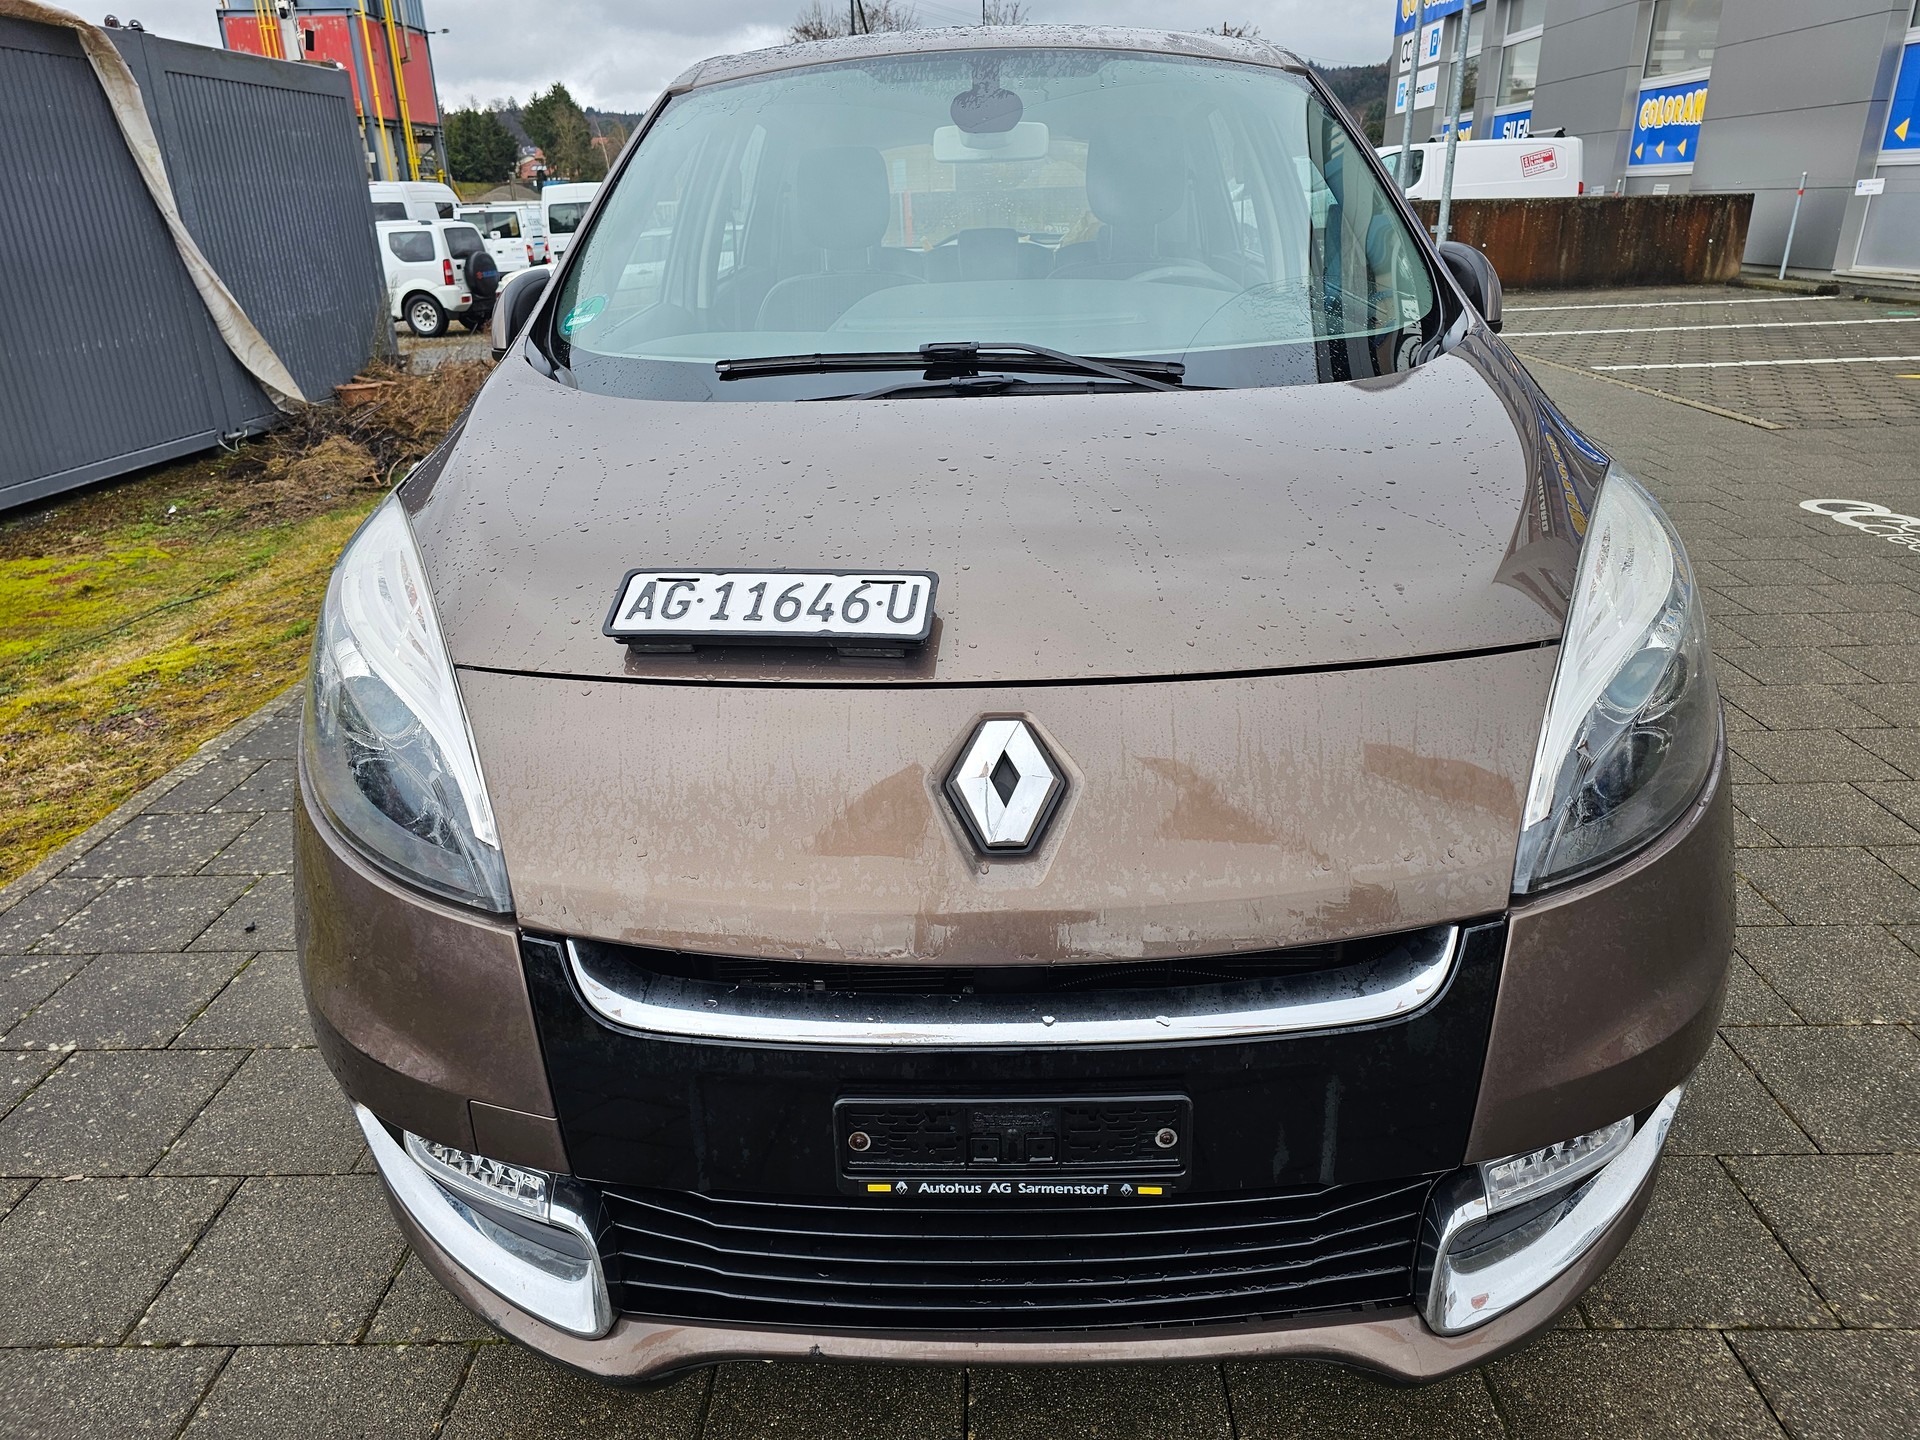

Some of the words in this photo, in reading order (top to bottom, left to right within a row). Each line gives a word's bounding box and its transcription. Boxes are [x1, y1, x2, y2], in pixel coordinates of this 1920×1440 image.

[918, 1182, 982, 1194] Autohus
[987, 1182, 1012, 1194] AG
[1018, 1182, 1110, 1195] Sarmenstorf
